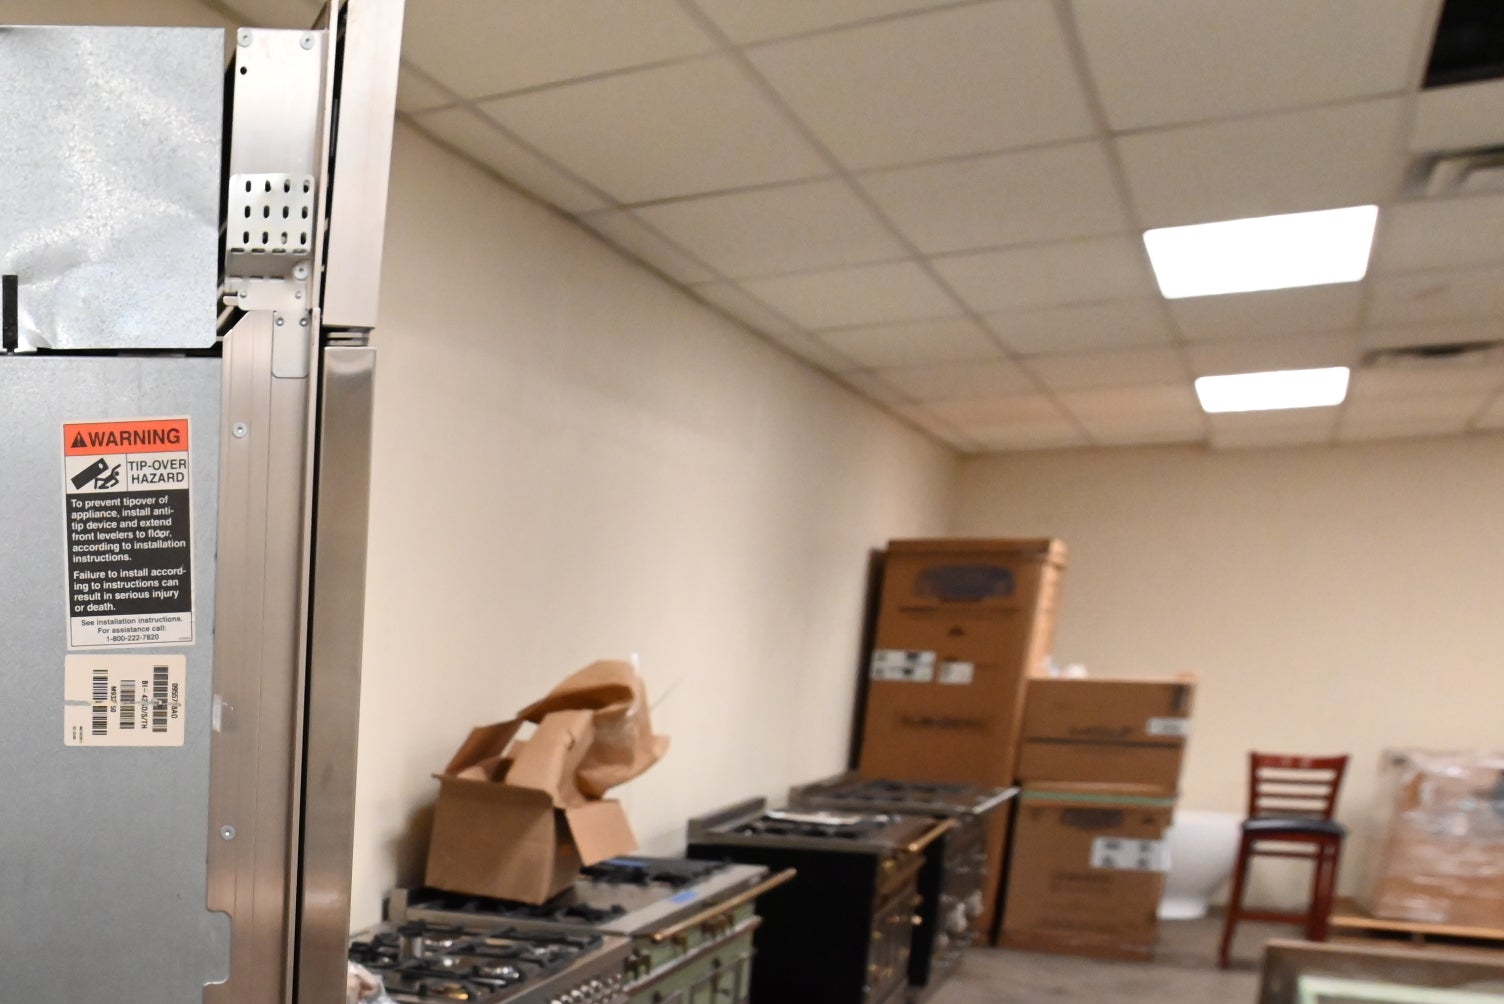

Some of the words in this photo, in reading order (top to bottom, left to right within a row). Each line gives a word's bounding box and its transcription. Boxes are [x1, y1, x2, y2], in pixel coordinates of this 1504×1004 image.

[88, 428, 181, 447] WARNING
[128, 459, 187, 471] TIP-OVER
[131, 472, 185, 484] HAZARD
[71, 499, 83, 508] To
[85, 498, 121, 510] prevent
[123, 496, 156, 507] tipover
[158, 495, 168, 504] of
[71, 509, 120, 521] appliance,
[122, 507, 151, 517] install
[153, 506, 174, 516] anti-
[71, 521, 84, 532] tip
[86, 520, 117, 530] device
[119, 519, 137, 528] and
[140, 517, 172, 527] extend
[71, 532, 94, 541] front
[97, 530, 133, 540] levelers
[136, 530, 145, 538] to
[72, 542, 120, 552] according
[122, 542, 131, 550] to
[134, 539, 186, 549] installation
[72, 553, 132, 563] instructions.
[73, 570, 105, 580] Failure
[108, 570, 117, 578] to
[120, 568, 149, 578] install
[151, 566, 187, 576] accord-
[74, 582, 89, 592] ing
[91, 581, 100, 590] to
[103, 579, 159, 589] instructions
[161, 579, 179, 587] can
[74, 592, 101, 601] result
[103, 592, 112, 600] in
[115, 590, 150, 600] serious
[152, 589, 179, 600] injury
[74, 604, 85, 612] or
[87, 602, 116, 612] death.
[81, 619, 94, 627] See
[96, 618, 136, 626] installation
[138, 616, 183, 624] instructions.
[111, 626, 150, 634] assistance
[106, 633, 160, 642] 1-800-222-7820
